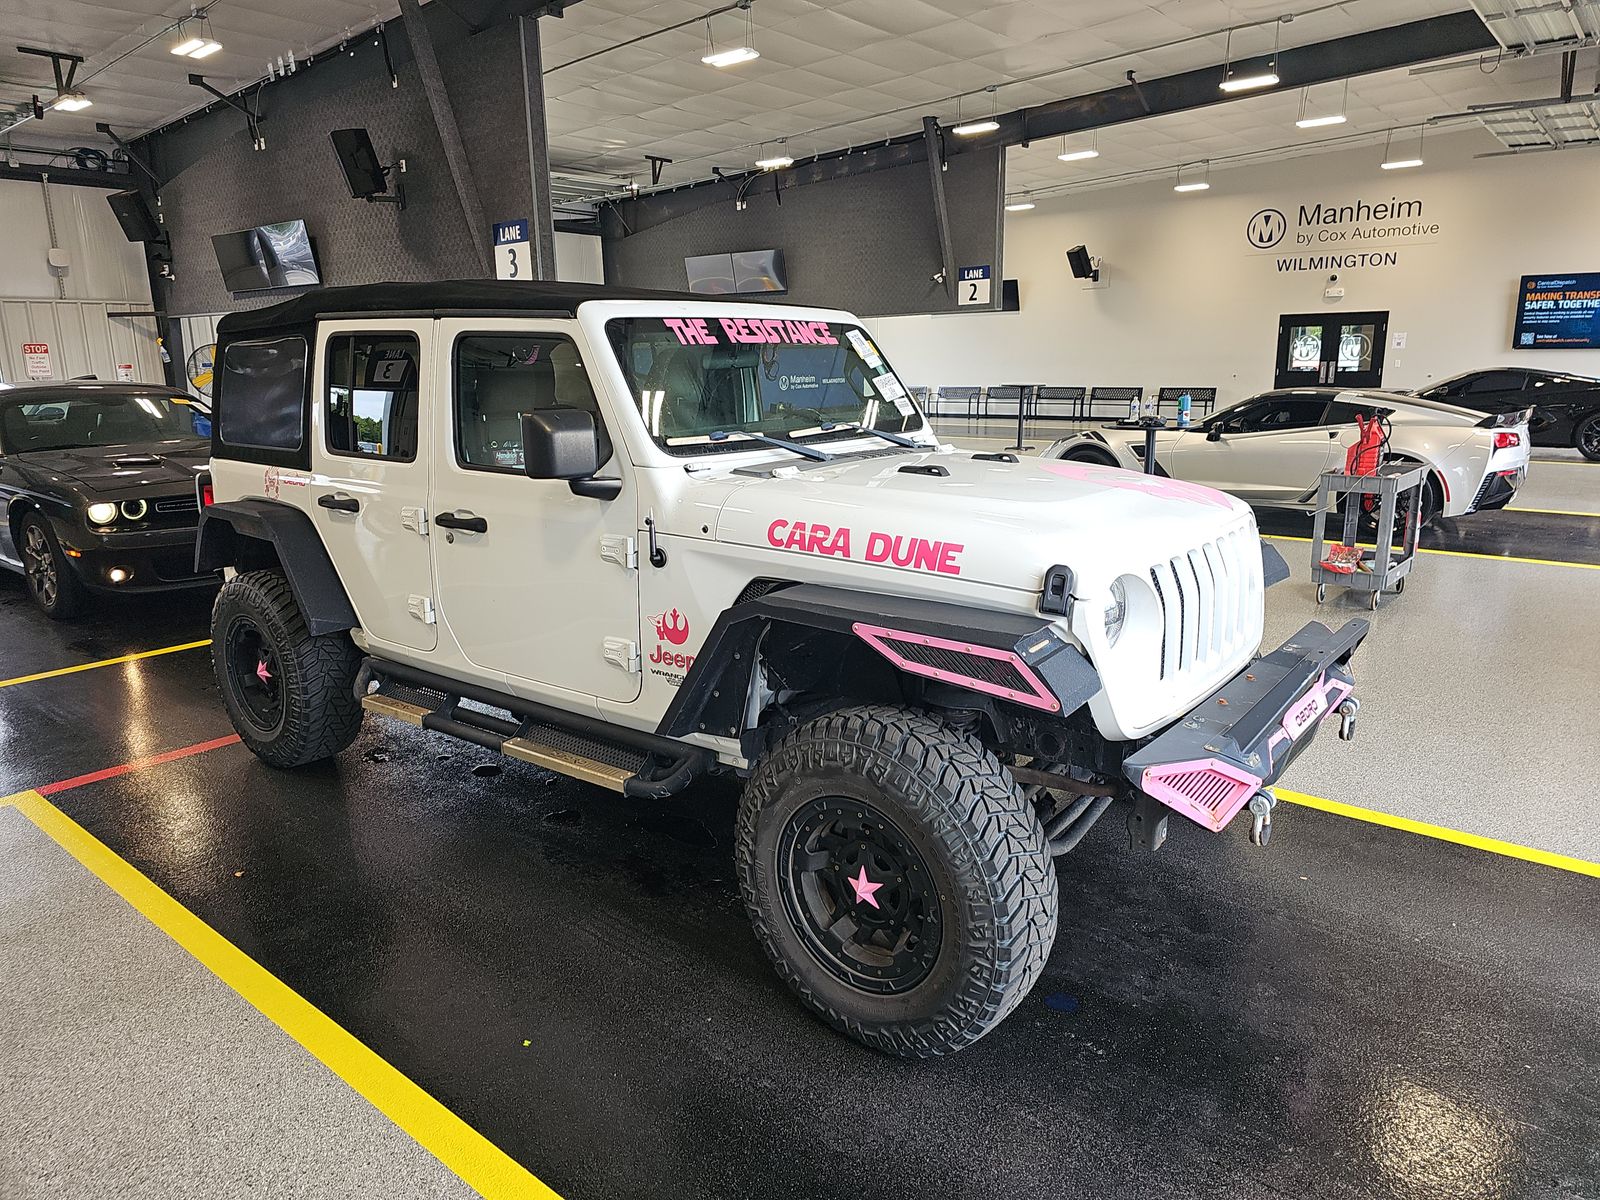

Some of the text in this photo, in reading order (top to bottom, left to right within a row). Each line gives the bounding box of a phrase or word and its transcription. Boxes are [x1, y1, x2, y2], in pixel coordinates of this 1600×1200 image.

[1298, 197, 1423, 227] Manheim
[499, 225, 521, 241] LANE
[1296, 222, 1440, 247] by Cox Automotive
[507, 248, 519, 278] 3
[1276, 251, 1398, 272] WILMINGTON
[964, 268, 984, 279] LANE
[968, 282, 978, 301] 2
[1525, 292, 1563, 301] MAKING
[1524, 299, 1600, 310] SAFER. TOGETHE
[662, 317, 840, 346] THE RESISTANCE
[24, 345, 48, 353] STOP
[790, 375, 816, 384] Manheim
[767, 518, 965, 576] CARA DUNE
[649, 644, 696, 673] Jeep
